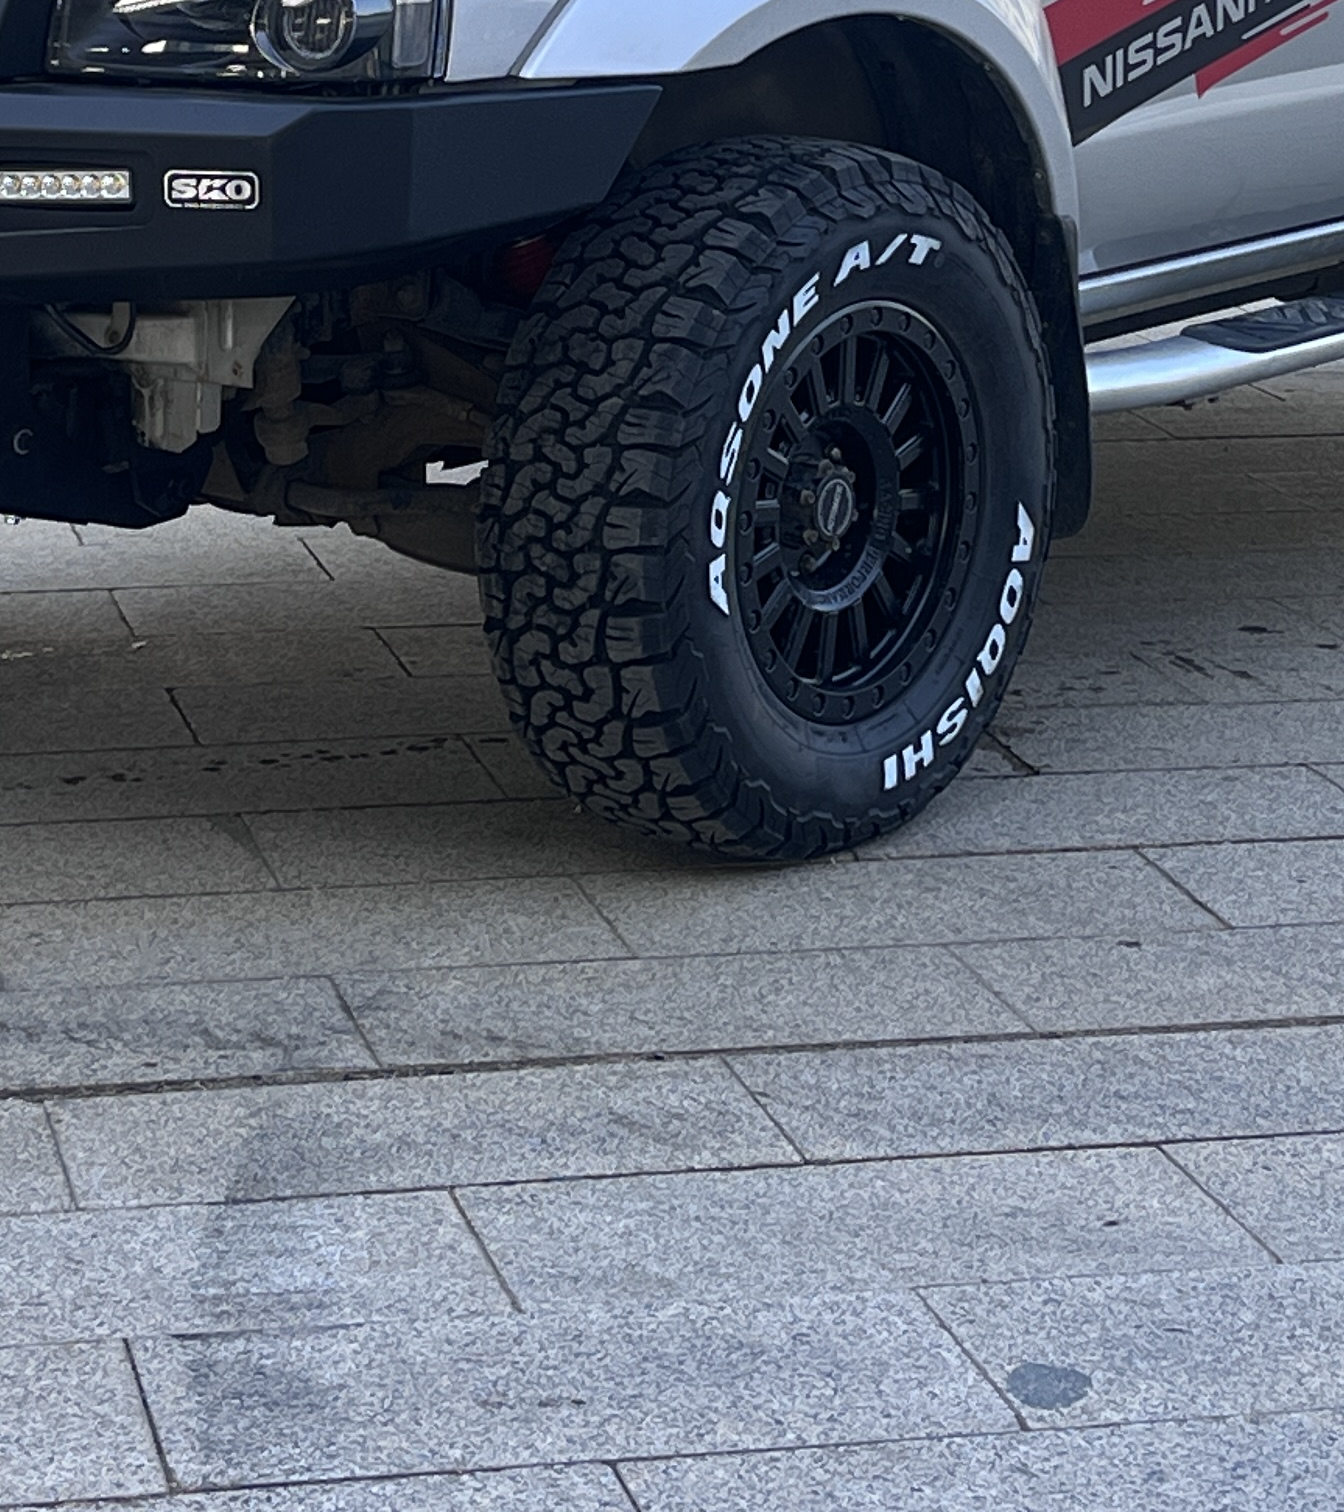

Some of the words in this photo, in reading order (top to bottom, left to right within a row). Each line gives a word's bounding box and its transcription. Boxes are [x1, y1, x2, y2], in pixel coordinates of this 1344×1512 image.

[709, 273, 820, 616] AQSONE
[833, 233, 942, 287] A/T
[883, 502, 1035, 790] AOQISHI
